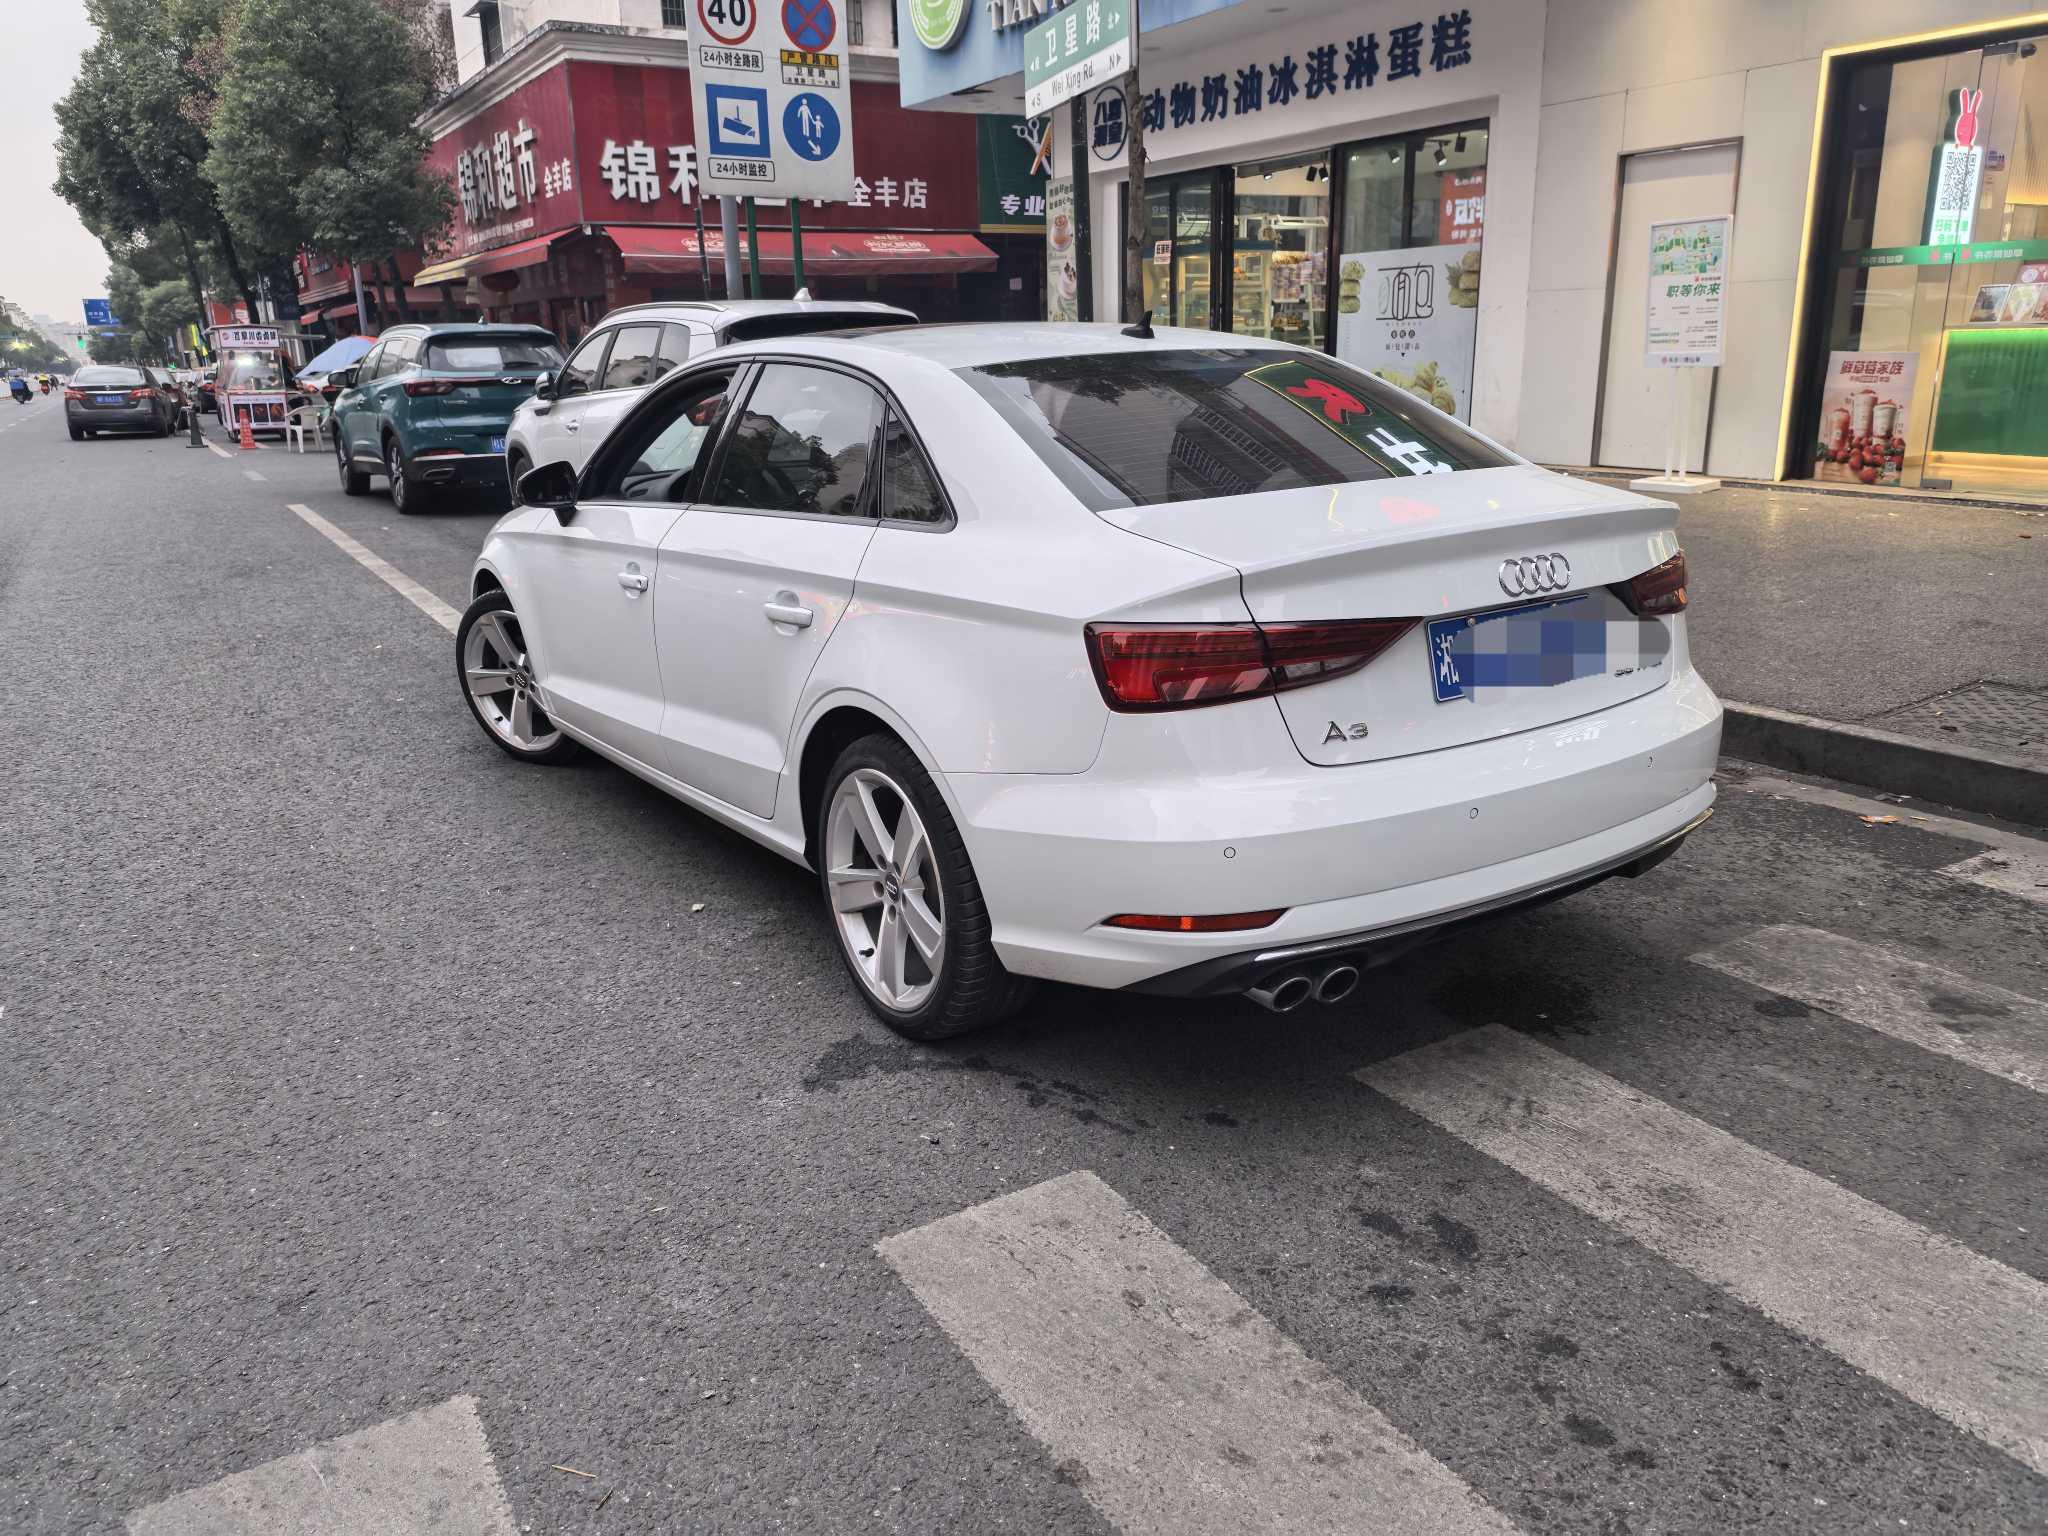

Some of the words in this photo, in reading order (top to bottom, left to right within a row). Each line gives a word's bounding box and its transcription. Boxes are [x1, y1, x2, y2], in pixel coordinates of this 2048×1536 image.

[708, 0, 746, 26] 40
[1045, 0, 1101, 68] 卫星路
[703, 51, 761, 69] 24小时全路段
[1142, 9, 1473, 134] 动物奶油冰淇淋蛋糕
[1051, 79, 1064, 97] Wei
[1065, 70, 1081, 88] Xing
[1109, 53, 1115, 71] N
[458, 118, 537, 225] 锦和超市
[543, 157, 573, 199] 全丰店
[716, 162, 767, 177] 24小时监控
[848, 176, 928, 209] 全丰店
[1000, 194, 1046, 216] 专业
[1665, 282, 1721, 299] 职等你来
[1320, 719, 1369, 745] A3
